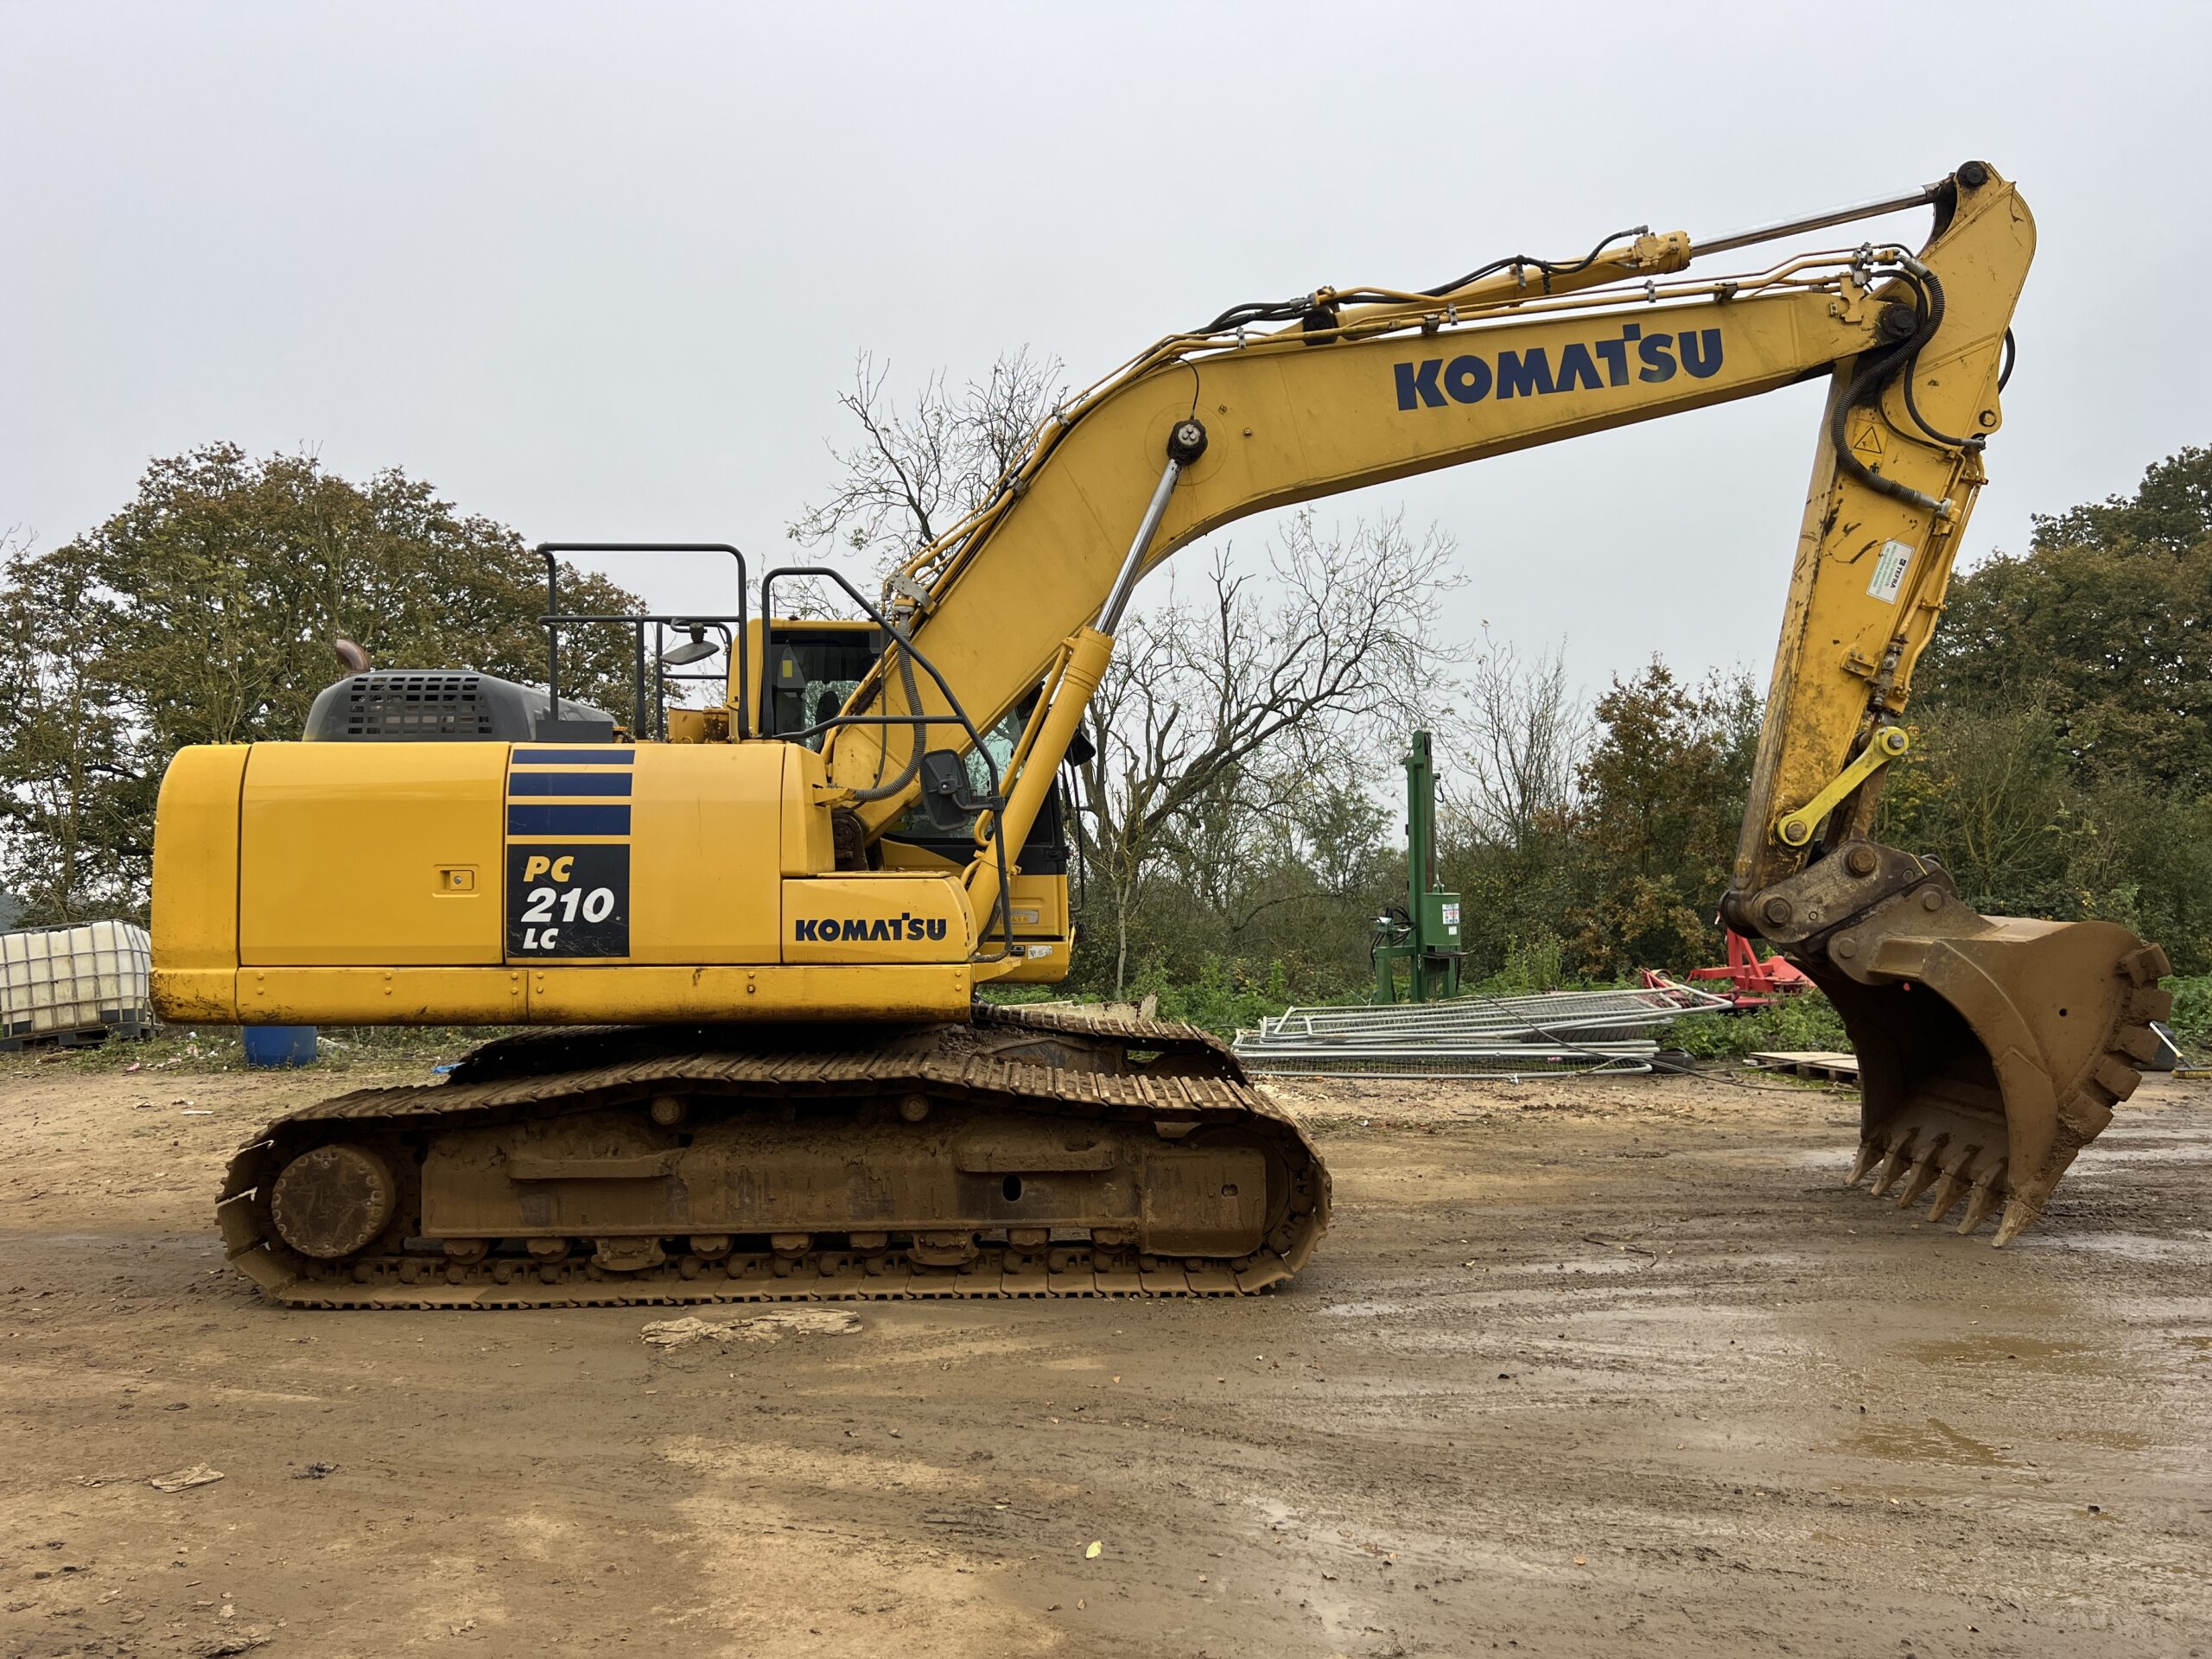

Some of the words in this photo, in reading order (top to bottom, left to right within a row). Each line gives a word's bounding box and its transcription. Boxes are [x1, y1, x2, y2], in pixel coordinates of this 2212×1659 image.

[1393, 323, 1724, 410] KOMATSU
[523, 855, 575, 882] PC
[520, 887, 614, 923] 210
[523, 928, 559, 950] LC
[795, 912, 947, 941] KOMATSU
